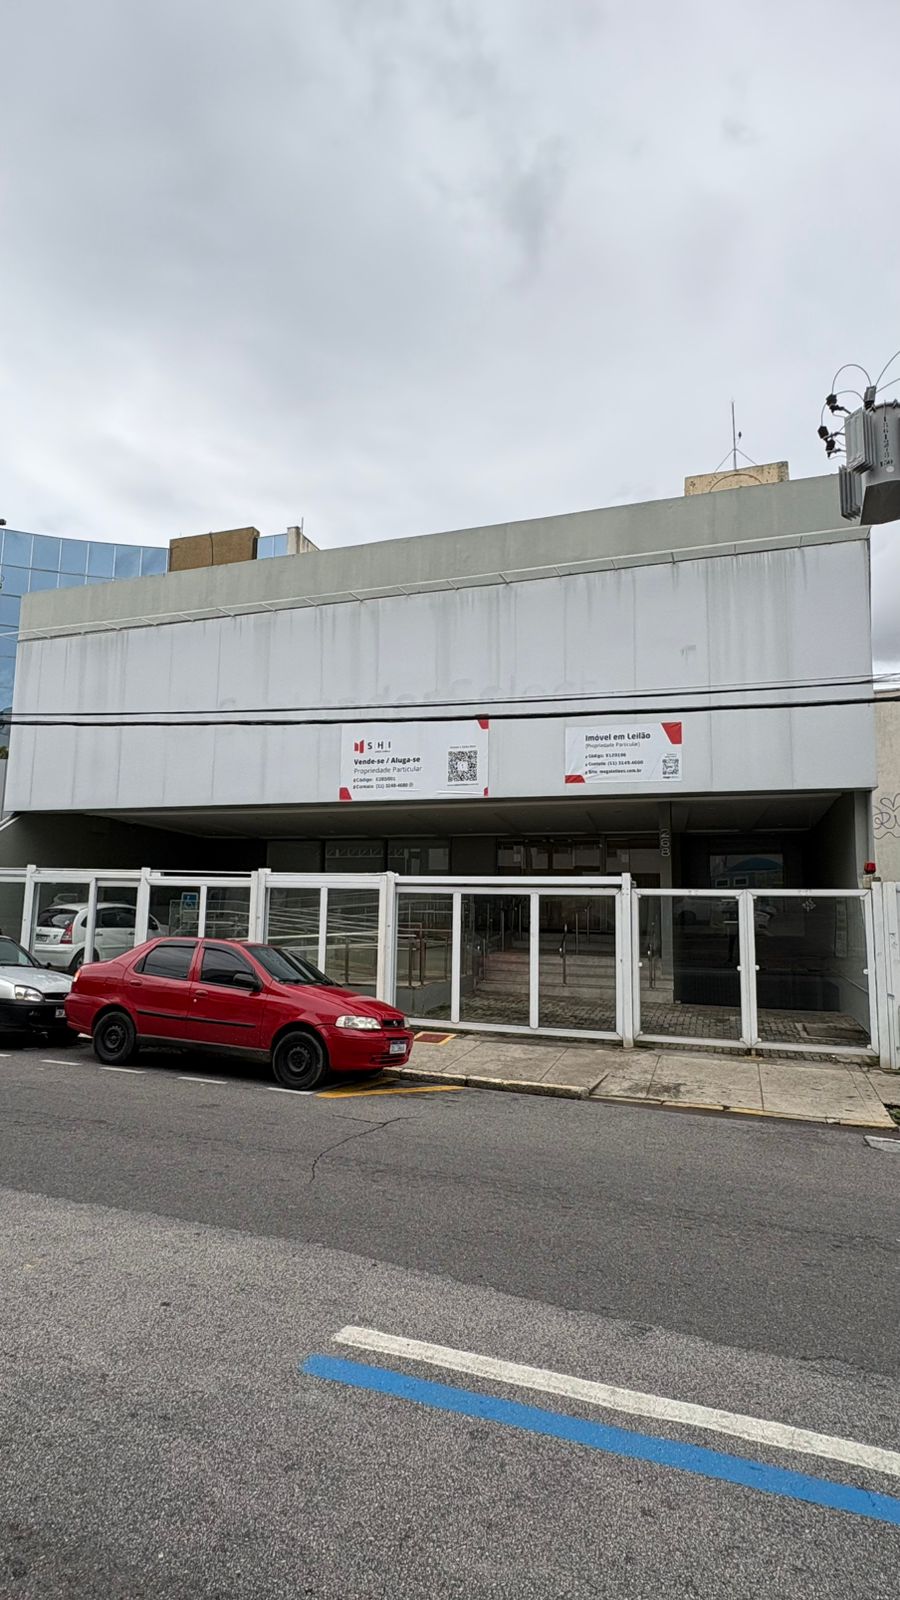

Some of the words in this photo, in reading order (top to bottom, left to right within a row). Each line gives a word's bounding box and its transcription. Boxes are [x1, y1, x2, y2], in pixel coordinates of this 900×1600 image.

[585, 733, 612, 742] Imóvel
[627, 732, 651, 740] Leilão
[390, 757, 421, 765] Aluga-se
[353, 767, 391, 775] Propriedade
[660, 828, 670, 857] 268
